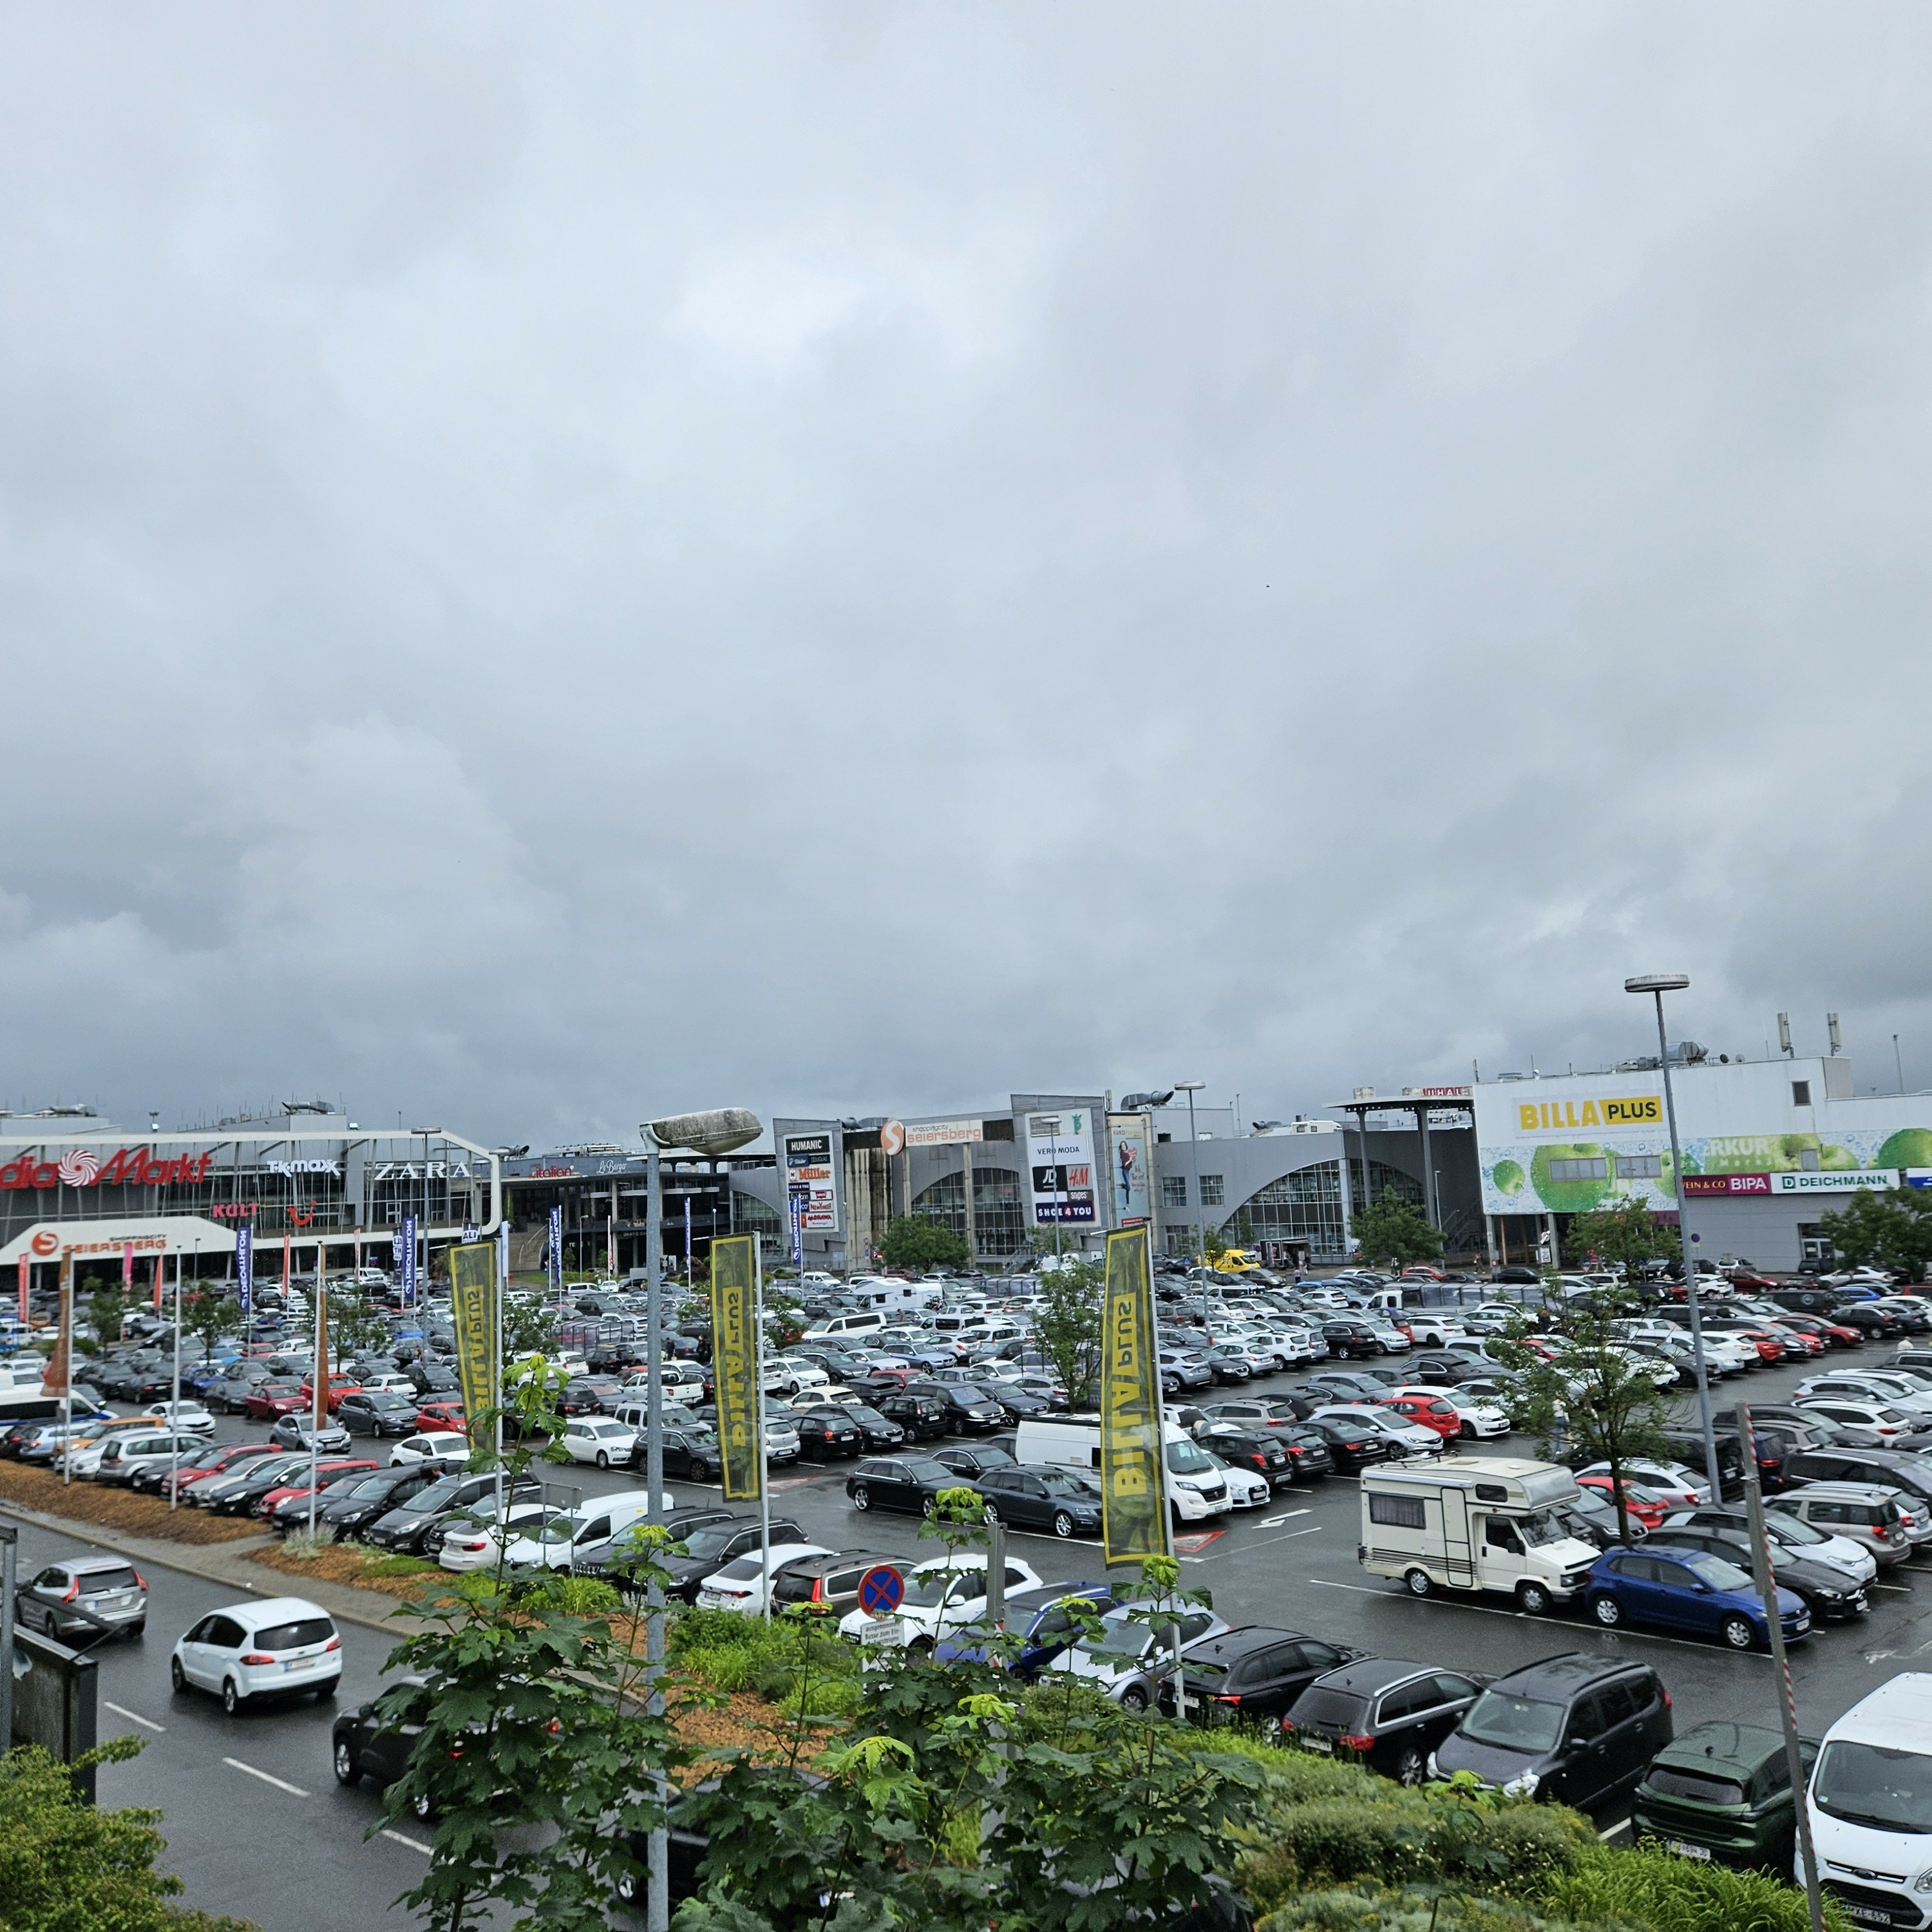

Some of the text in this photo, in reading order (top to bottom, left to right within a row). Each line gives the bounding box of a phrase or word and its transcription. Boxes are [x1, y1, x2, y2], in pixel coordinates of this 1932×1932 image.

[1520, 1100, 1657, 1130] BILLA PLUS
[907, 1128, 981, 1143] seiersberg
[791, 1139, 822, 1151] HUMANIC
[88, 1148, 212, 1186] Markt
[374, 1161, 472, 1180] ZARA
[799, 1167, 831, 1180] Müller
[1043, 1167, 1088, 1188] JD H&M
[1730, 1177, 1767, 1190] BIPA
[1800, 1175, 1888, 1187] DEICHMANN
[213, 1202, 260, 1218] KULT
[1038, 1206, 1092, 1217] SHOE 4 YOU
[63, 1240, 166, 1253] SEIERSERG
